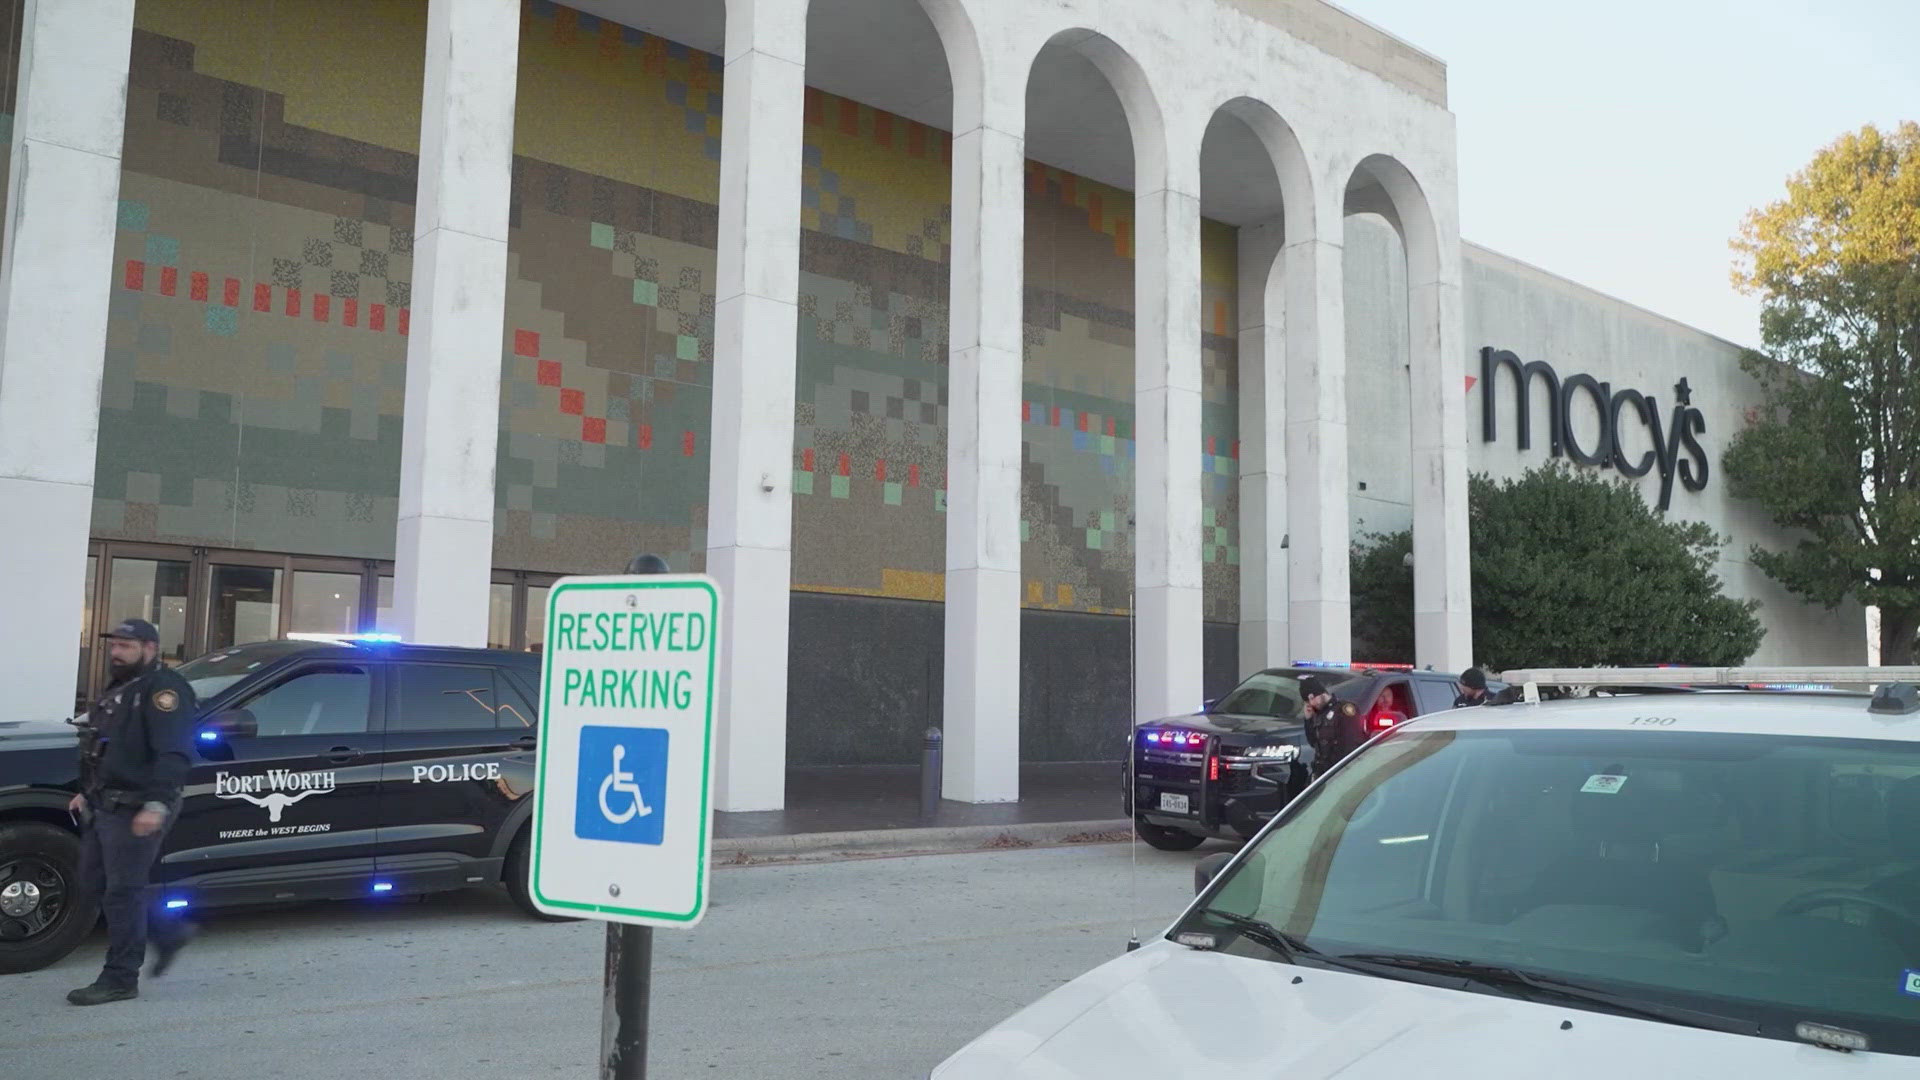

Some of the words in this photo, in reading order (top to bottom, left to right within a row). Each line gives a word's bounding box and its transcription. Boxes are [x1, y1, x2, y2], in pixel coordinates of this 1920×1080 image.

[557, 613, 706, 651] RESERVED
[563, 669, 692, 710] PARKING
[1629, 716, 1677, 726] 190
[215, 771, 264, 795] FORT
[267, 769, 336, 791] WORTH
[412, 762, 502, 784] POLICE
[219, 828, 254, 839] WHERE
[255, 828, 269, 836] the
[271, 826, 297, 835] WEST
[297, 823, 331, 833] BEGINS
